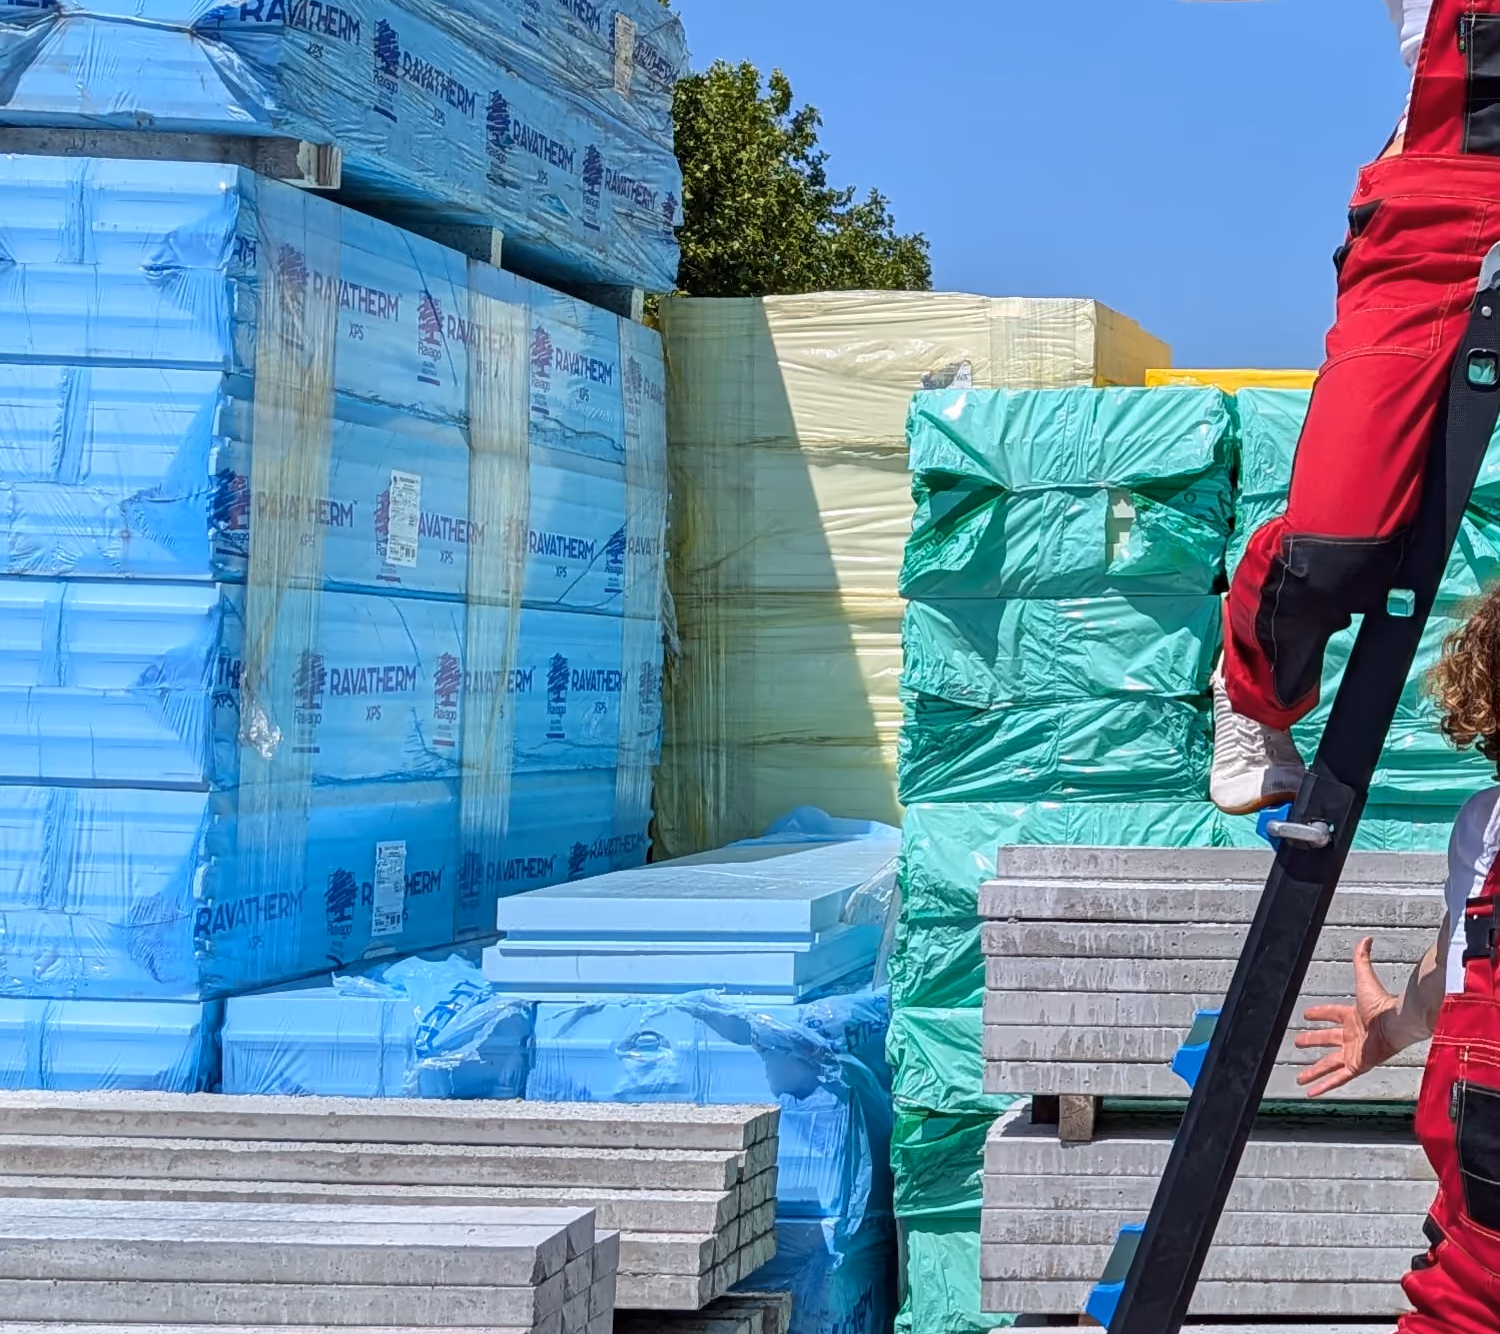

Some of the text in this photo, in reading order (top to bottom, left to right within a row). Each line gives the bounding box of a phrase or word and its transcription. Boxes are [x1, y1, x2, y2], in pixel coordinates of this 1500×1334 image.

[402, 51, 476, 119] RAVATHERM
[512, 118, 574, 174] RAVATHERM
[604, 167, 657, 211] RAVATHERM
[312, 270, 399, 322] RAVATHERM
[349, 323, 364, 340] XPS
[555, 347, 613, 386] RAVATHERM
[418, 511, 486, 545] AVATHERM
[440, 549, 454, 565] XPS
[529, 530, 595, 560] RAVATHERM
[329, 665, 417, 696] RAVATHERM
[571, 669, 628, 692] RAVATHERM
[366, 705, 382, 721] XPS
[485, 856, 554, 885] RAVATHERM
[194, 889, 304, 938] RAVATHERM
